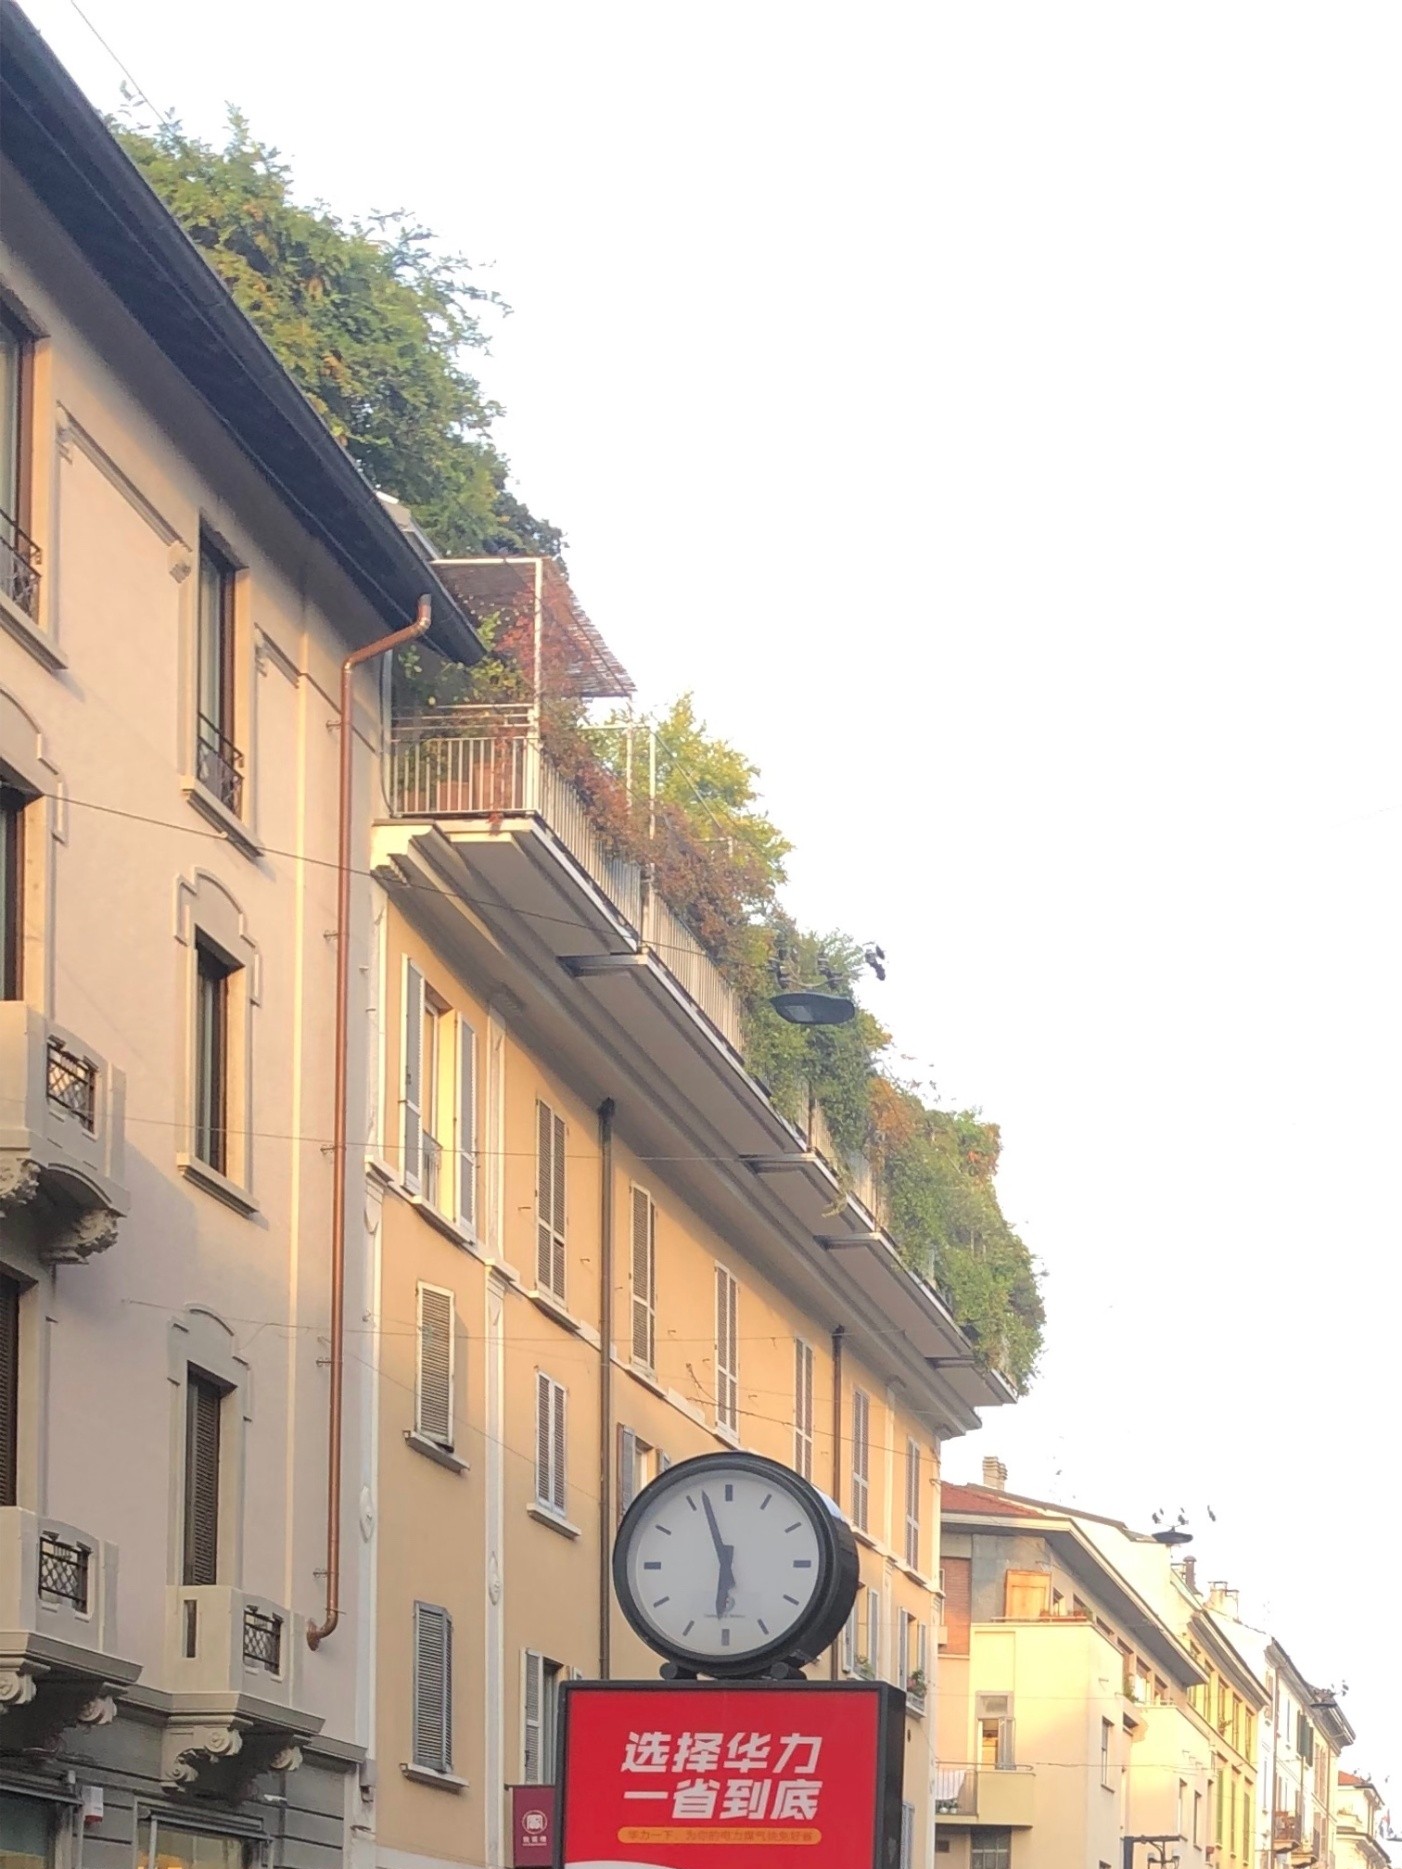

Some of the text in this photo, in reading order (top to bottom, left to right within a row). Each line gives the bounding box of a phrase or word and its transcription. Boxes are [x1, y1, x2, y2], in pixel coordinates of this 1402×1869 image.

[620, 1730, 824, 1774] 选择华力
[623, 1778, 823, 1820] 一省到底
